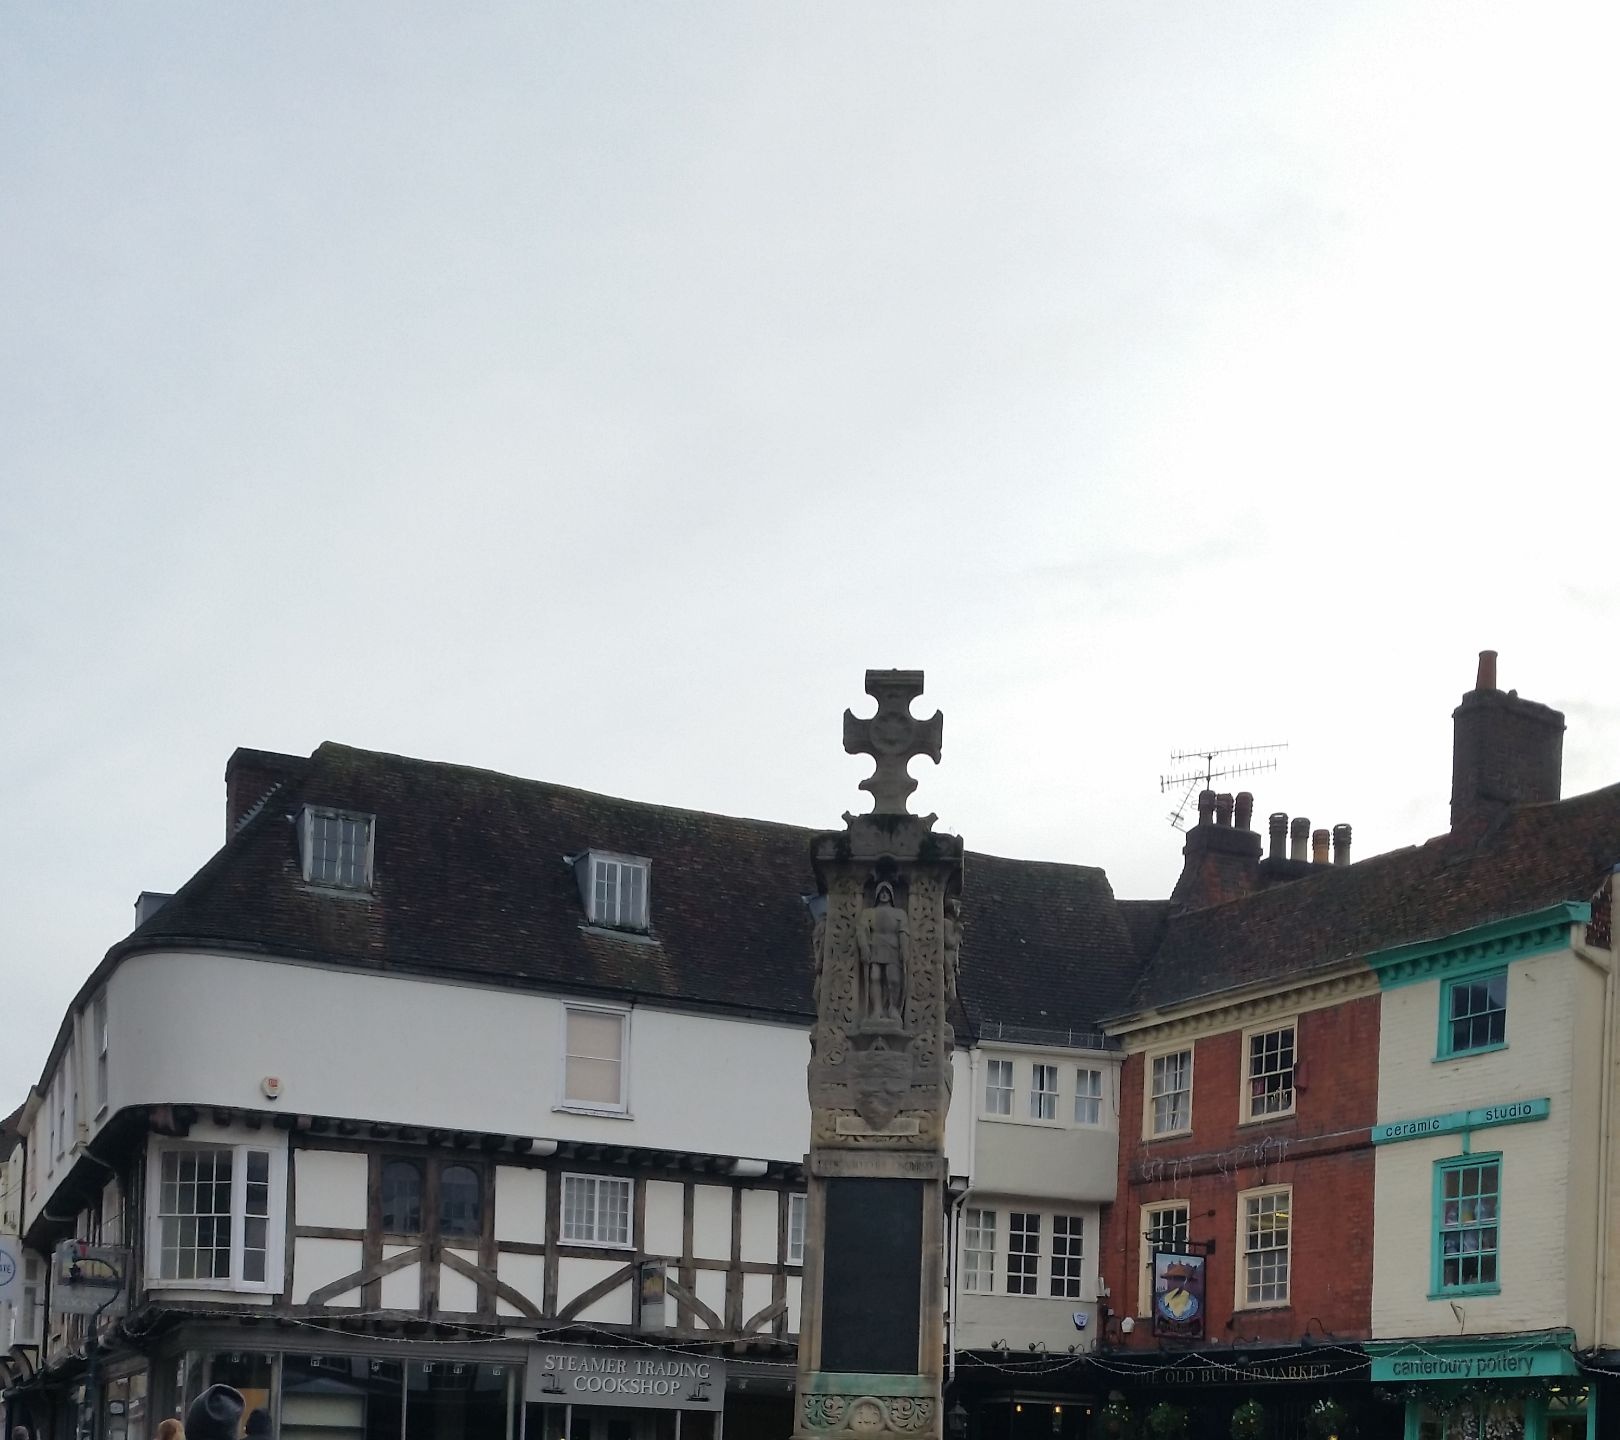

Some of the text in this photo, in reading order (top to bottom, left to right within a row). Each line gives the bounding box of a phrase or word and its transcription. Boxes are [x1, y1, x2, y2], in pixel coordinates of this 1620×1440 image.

[1385, 1103, 1532, 1137] ceramic studio
[544, 1354, 710, 1379] STEAMER TRADING
[1165, 1369, 1194, 1384] OLD
[1201, 1364, 1330, 1383] BUTTERMARKET
[1392, 1356, 1534, 1377] canterbury pottery
[573, 1375, 681, 1396] COOKSHOP
